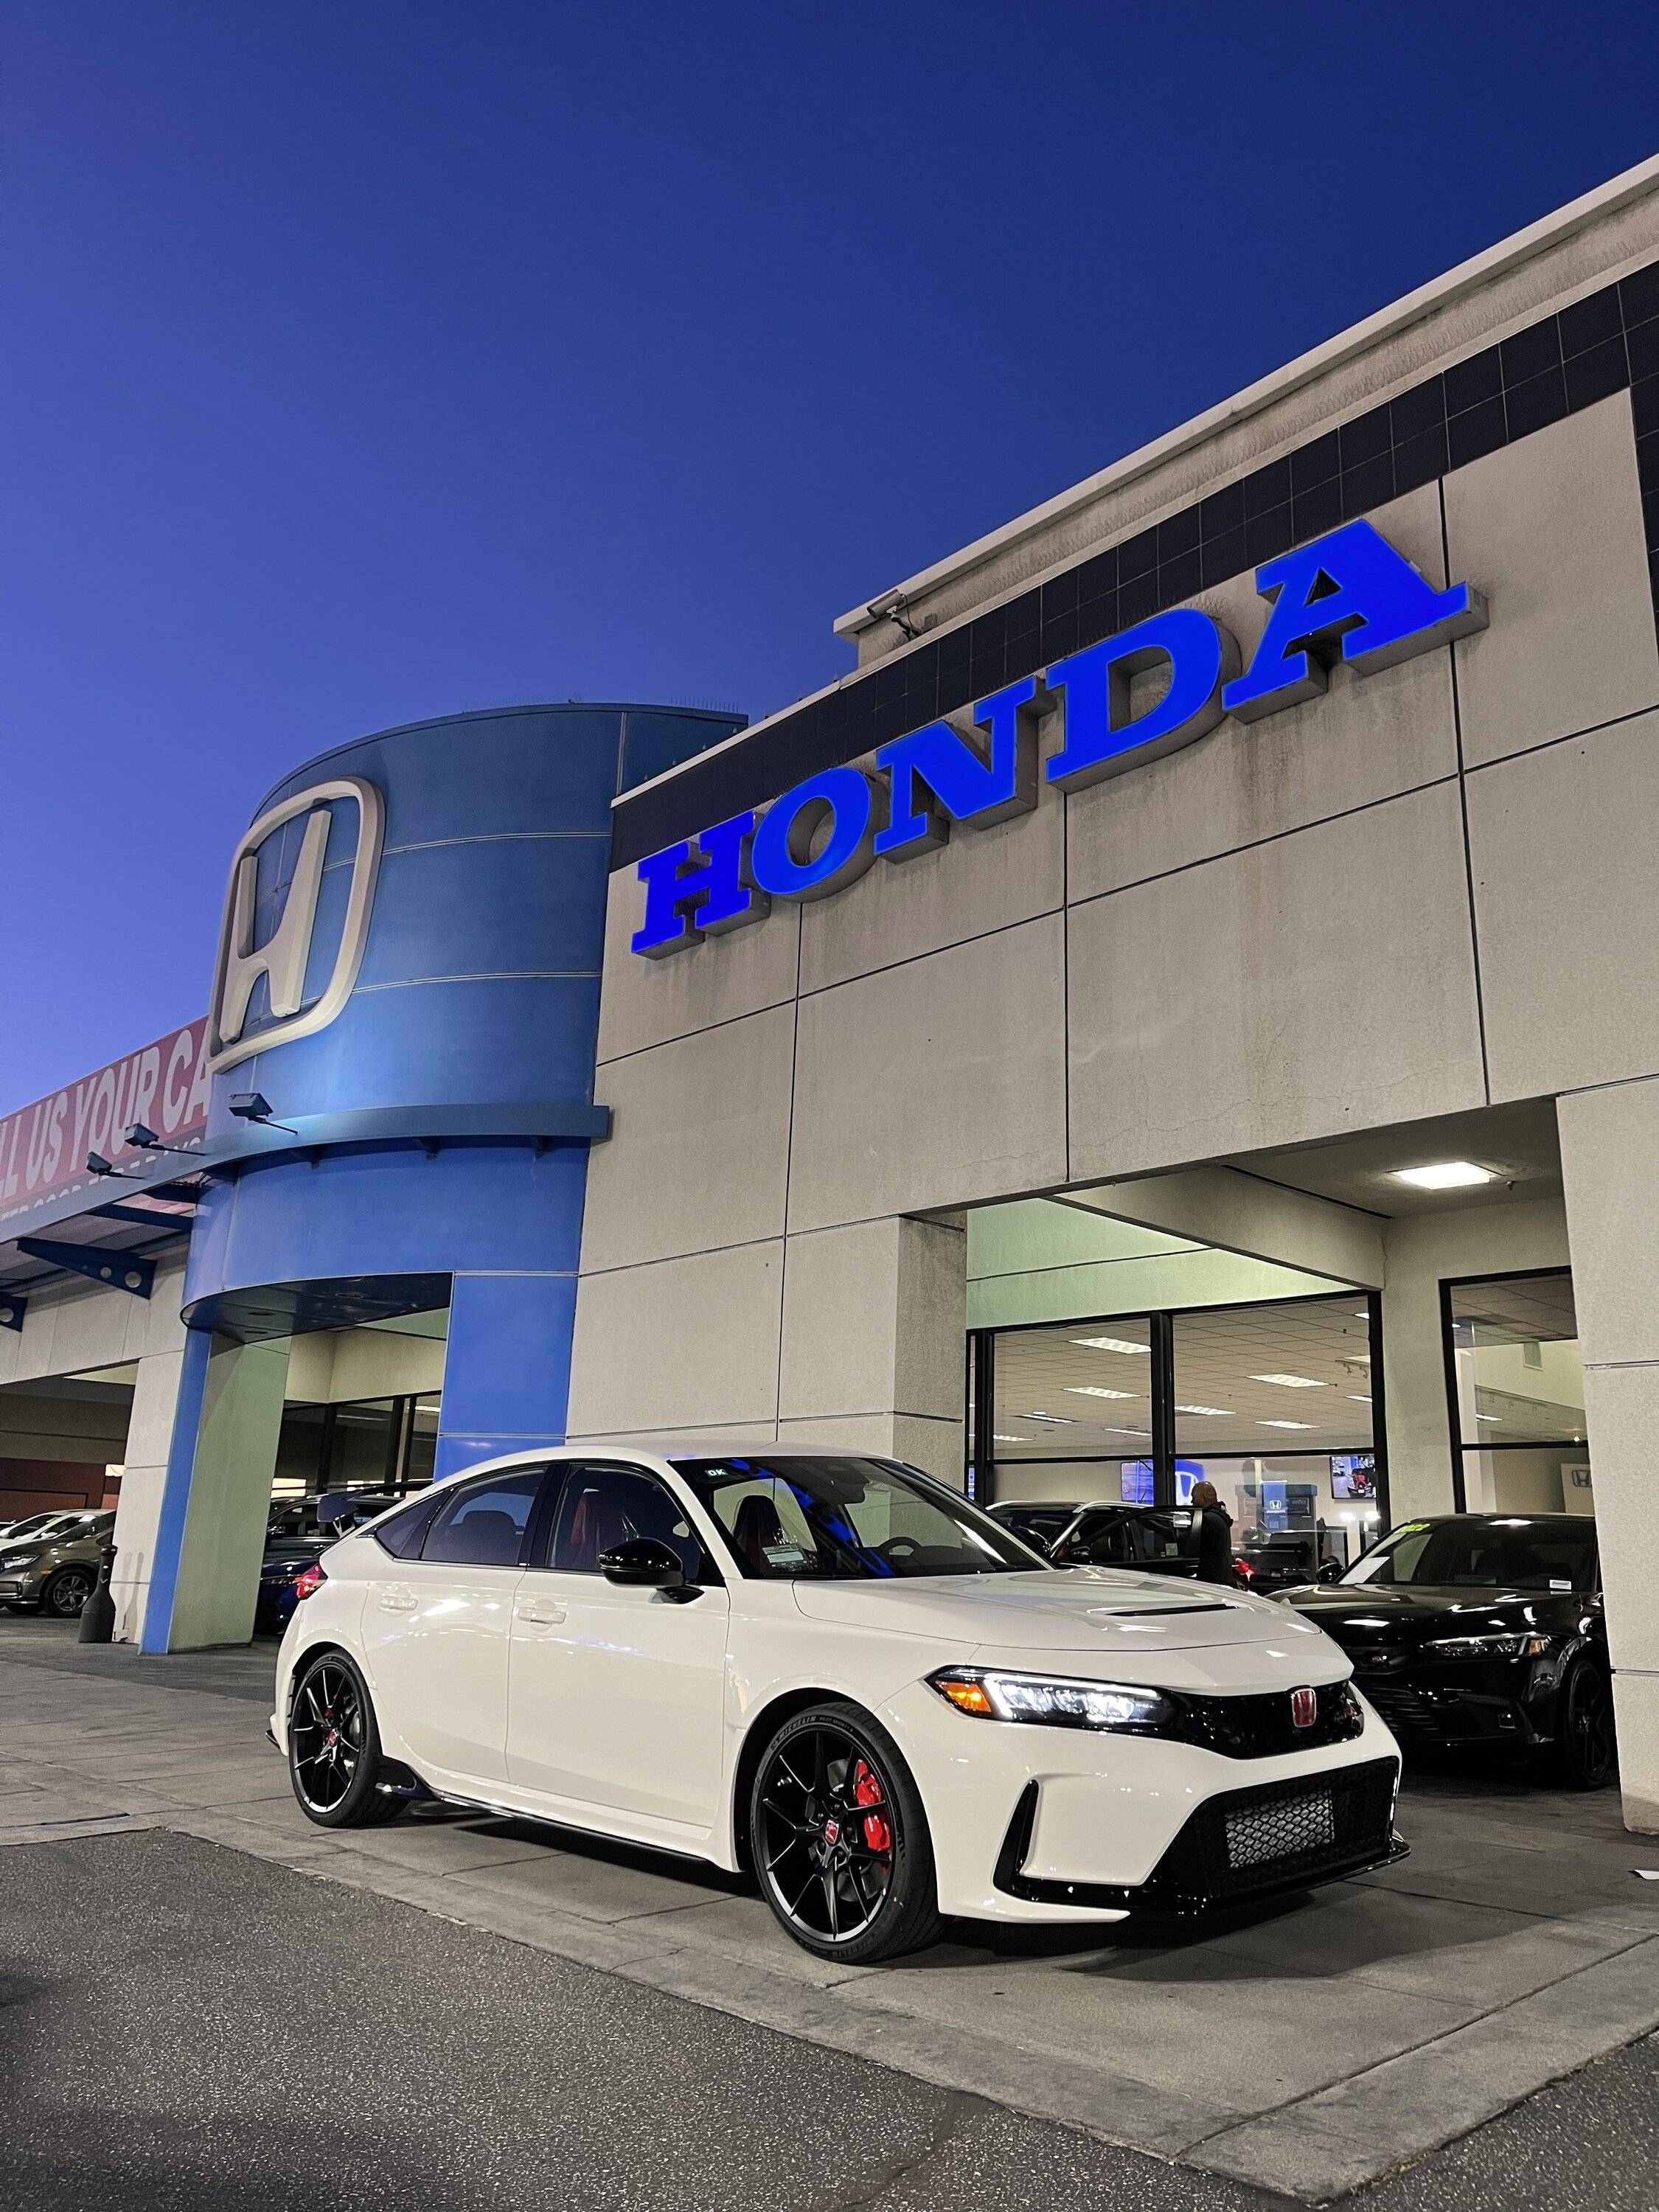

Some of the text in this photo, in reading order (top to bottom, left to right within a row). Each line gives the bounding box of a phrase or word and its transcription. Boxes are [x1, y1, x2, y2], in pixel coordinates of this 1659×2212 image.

[632, 518, 1474, 956] HONDA
[26, 1092, 68, 1191] US
[70, 1046, 160, 1172] YOUR
